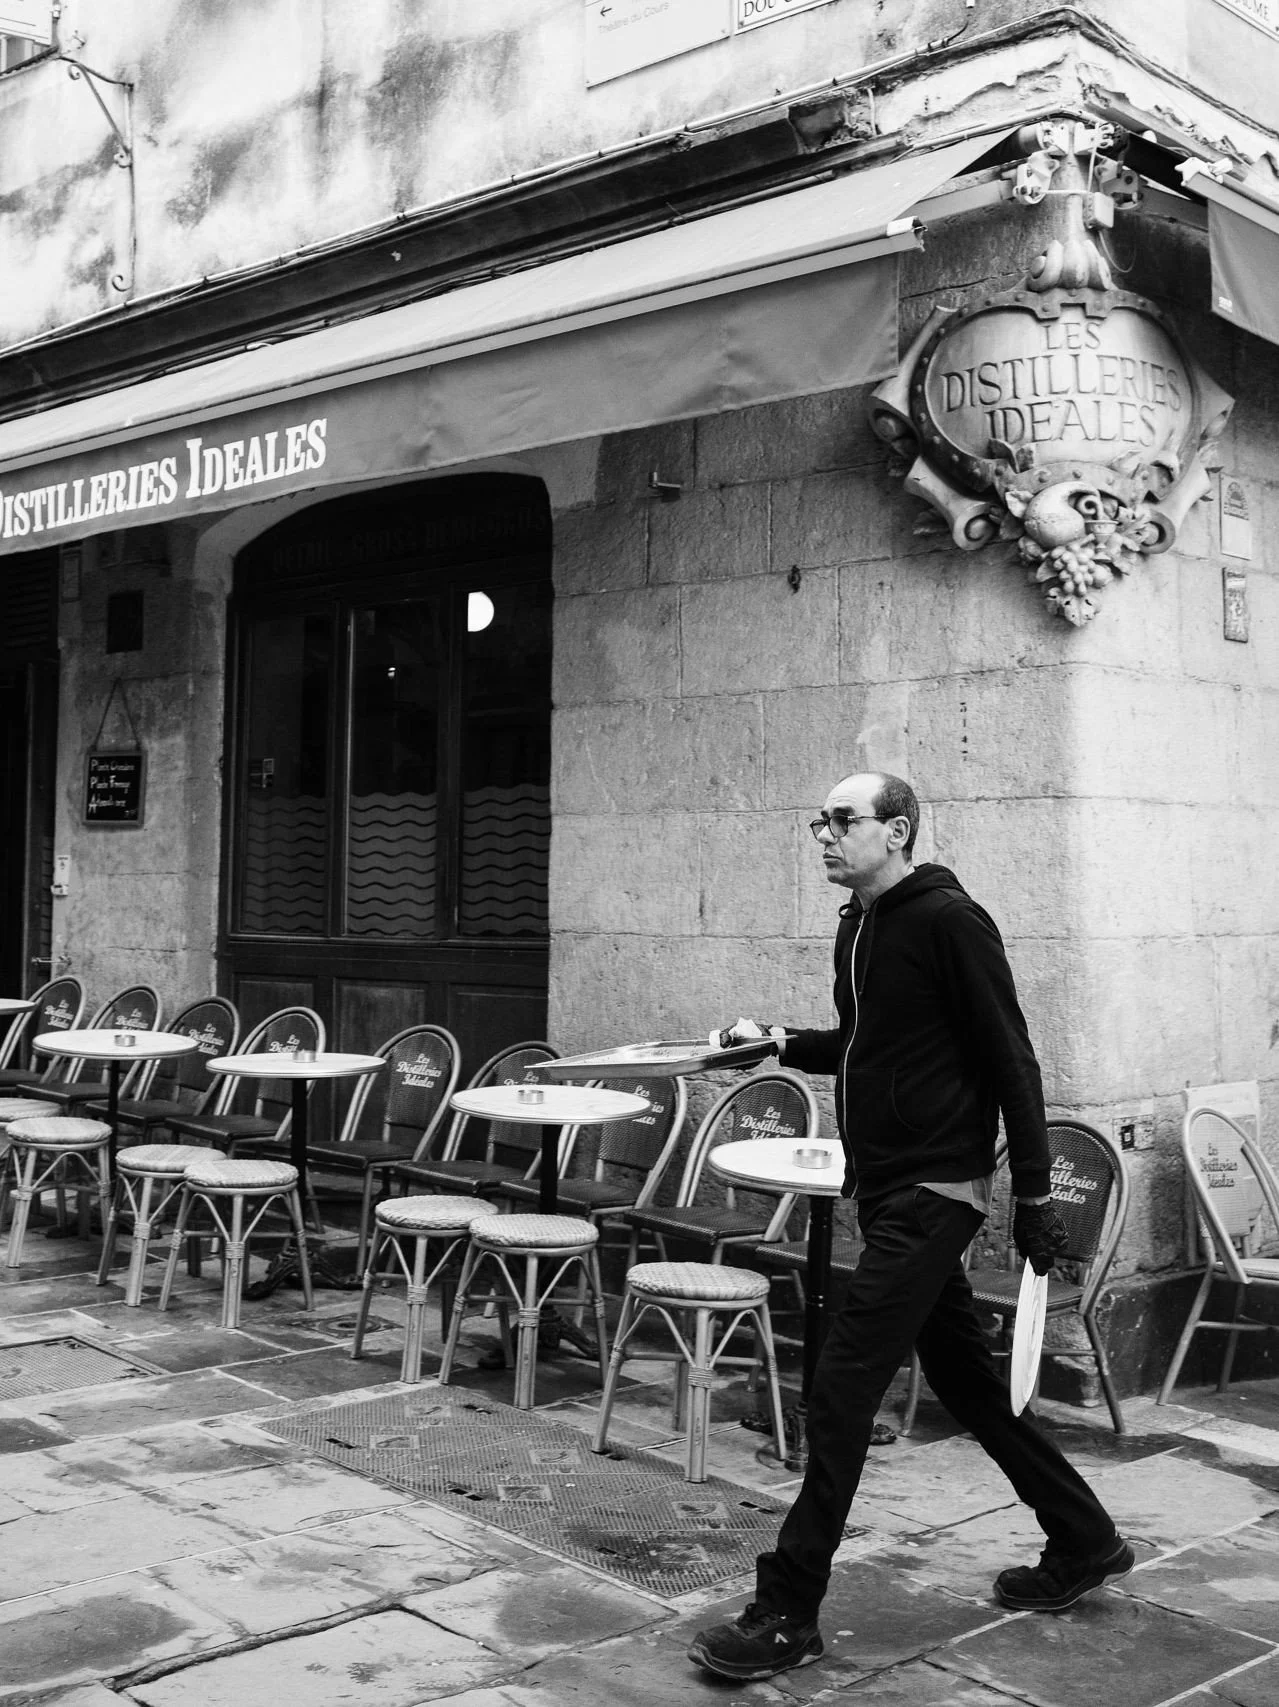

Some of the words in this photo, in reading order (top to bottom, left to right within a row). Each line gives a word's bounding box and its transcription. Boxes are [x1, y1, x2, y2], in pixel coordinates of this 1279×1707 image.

[1042, 321, 1101, 351] LES
[941, 353, 1182, 413] DISTILLERIES
[0, 455, 178, 538] ISTILLERIES
[185, 418, 328, 499] IDEALES
[1051, 1155, 1075, 1170] Les
[1050, 1169, 1097, 1190] tilleries
